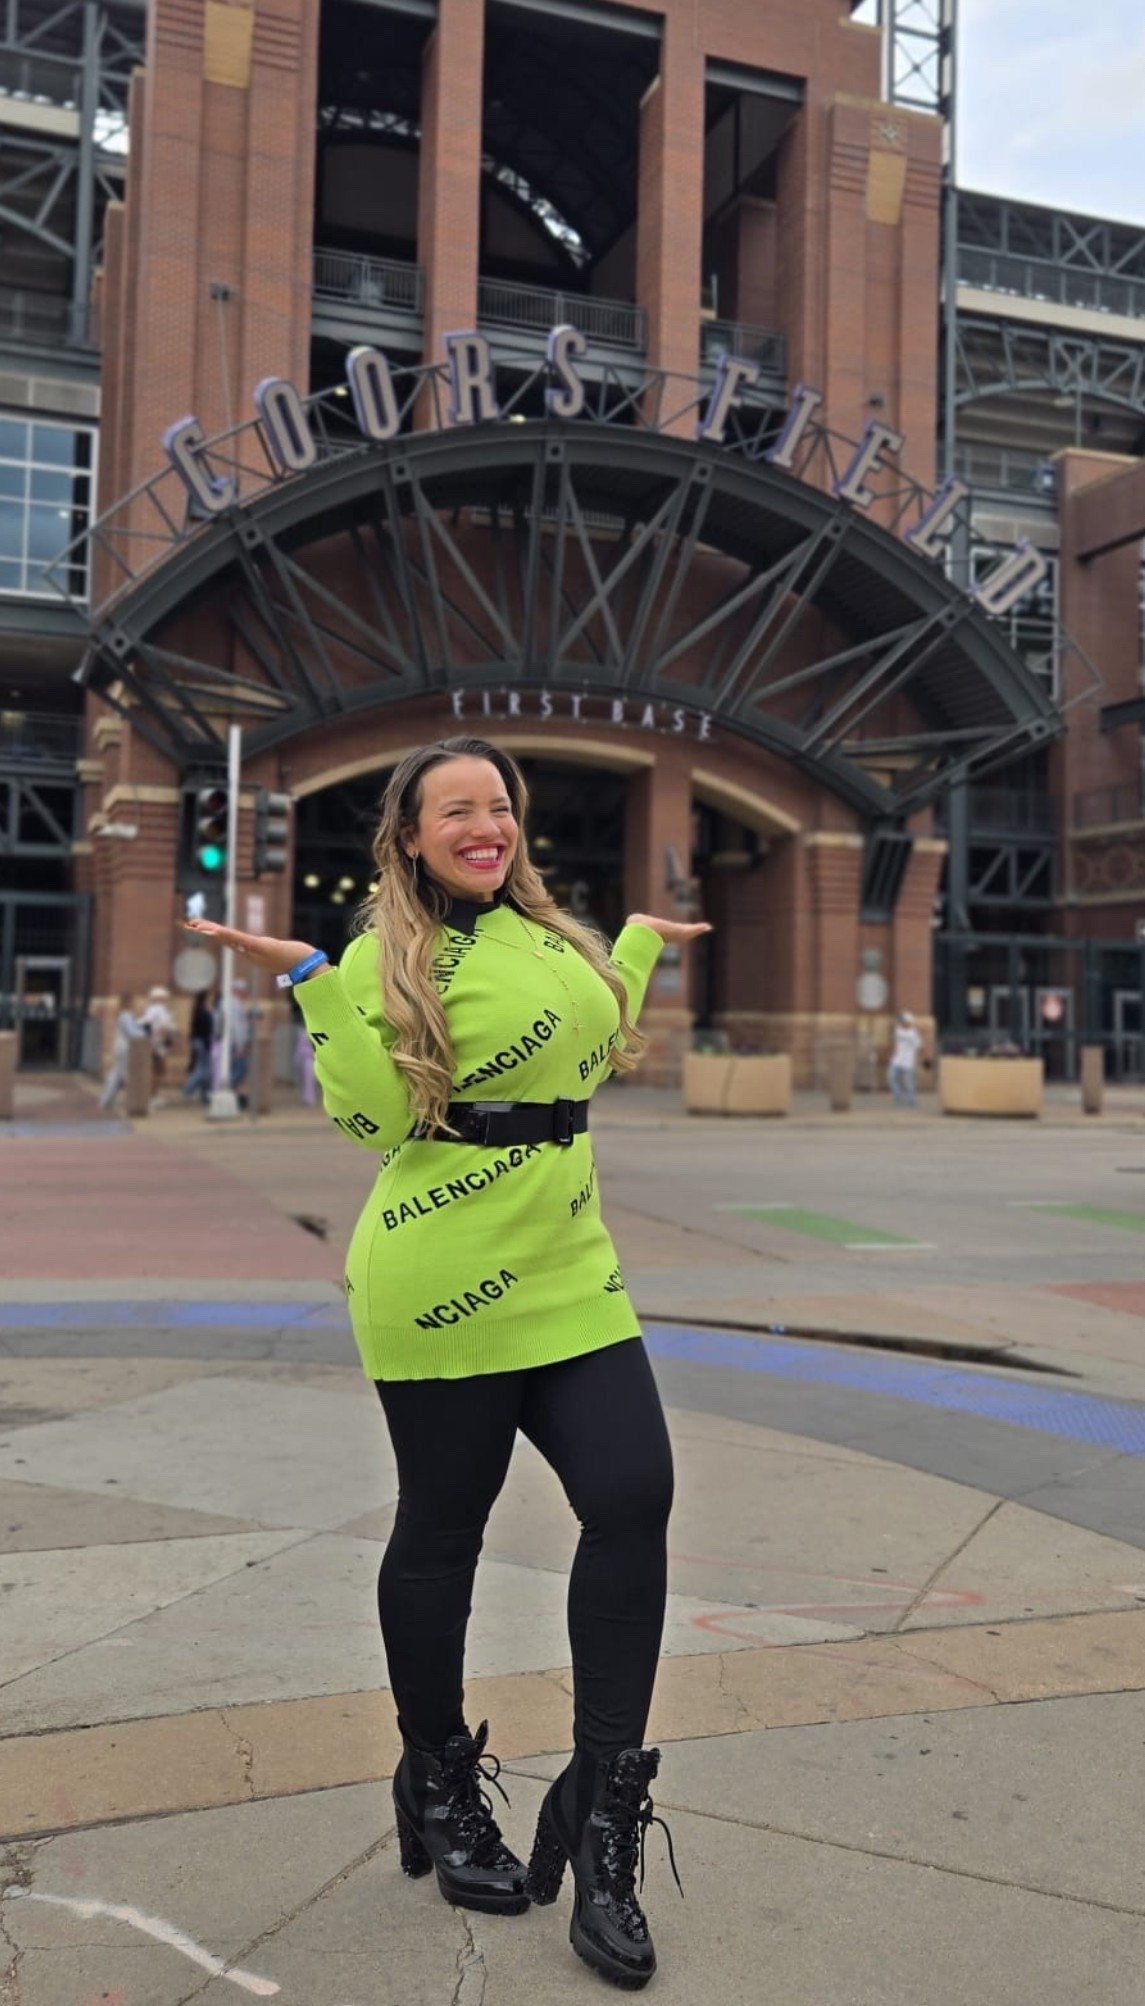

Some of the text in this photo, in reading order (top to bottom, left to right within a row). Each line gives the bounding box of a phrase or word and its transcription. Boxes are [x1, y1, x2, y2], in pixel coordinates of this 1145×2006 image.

[162, 324, 1047, 616] COORS FIELD
[451, 689, 713, 741] FIRST BASE
[381, 1143, 542, 1231] BALENCIAGA
[413, 1268, 519, 1330] NCIAGA
